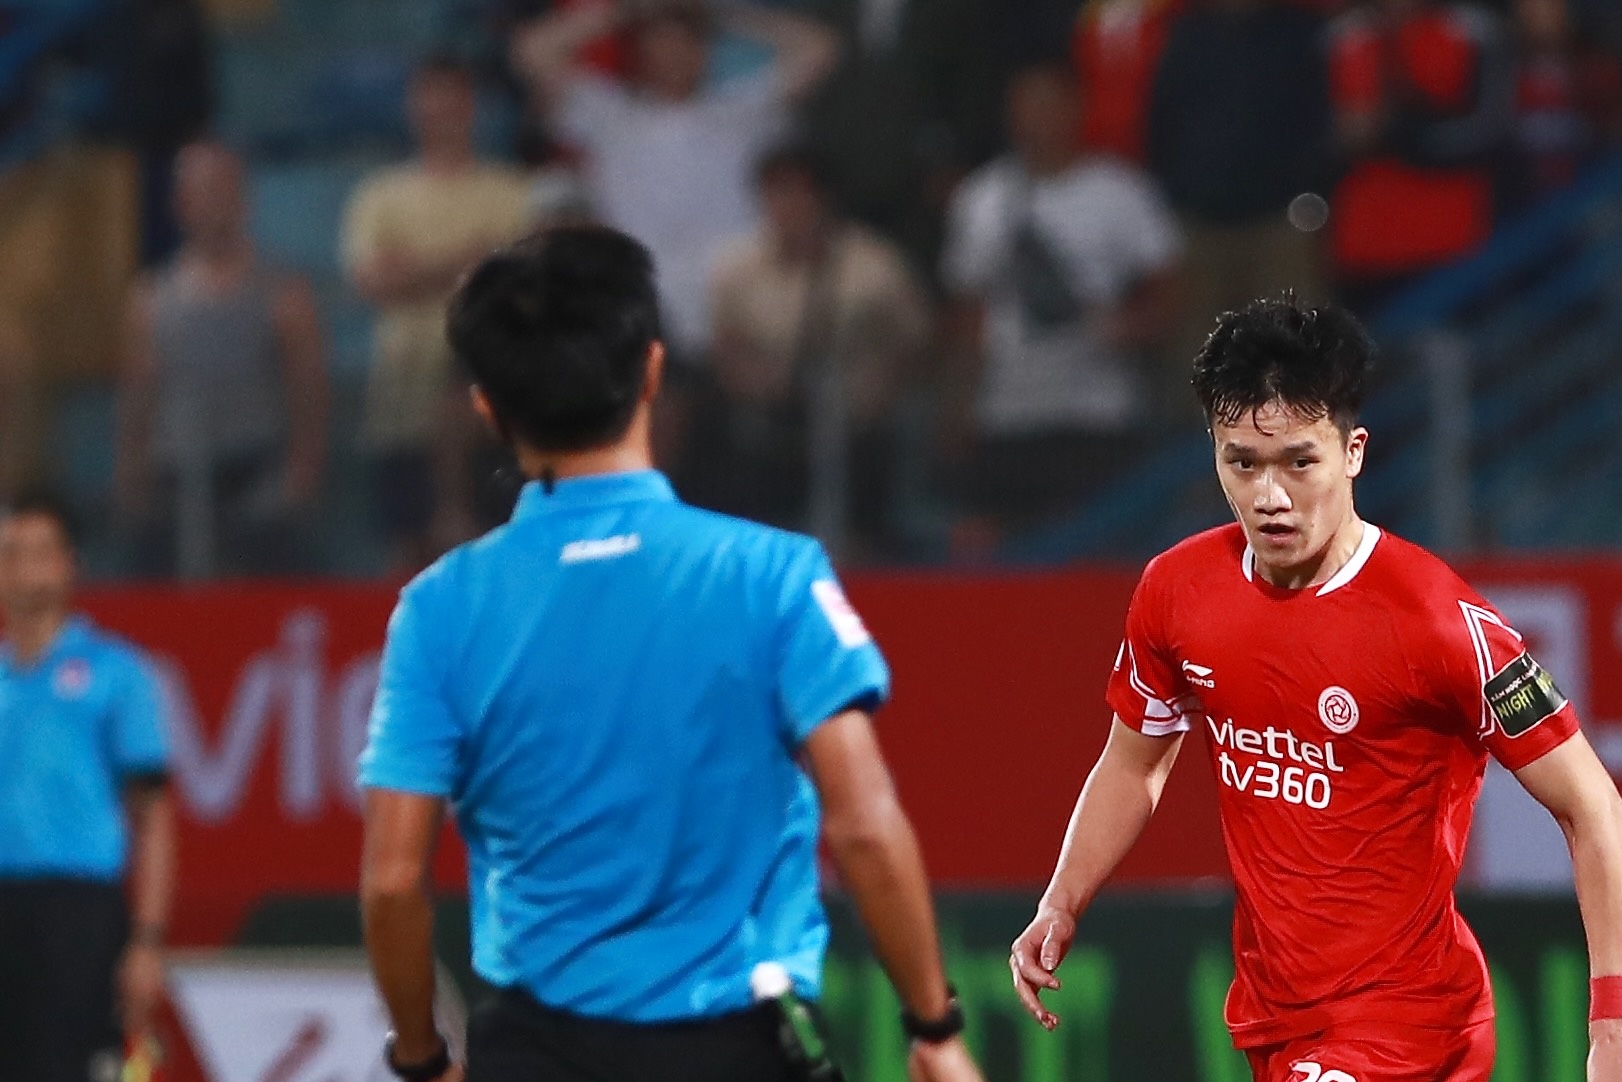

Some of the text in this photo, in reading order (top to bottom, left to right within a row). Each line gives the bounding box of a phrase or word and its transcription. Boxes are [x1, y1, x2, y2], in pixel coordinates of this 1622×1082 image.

[1496, 684, 1535, 718] NIGHT
[1206, 715, 1343, 772] viettel
[1219, 752, 1331, 809] tv360
